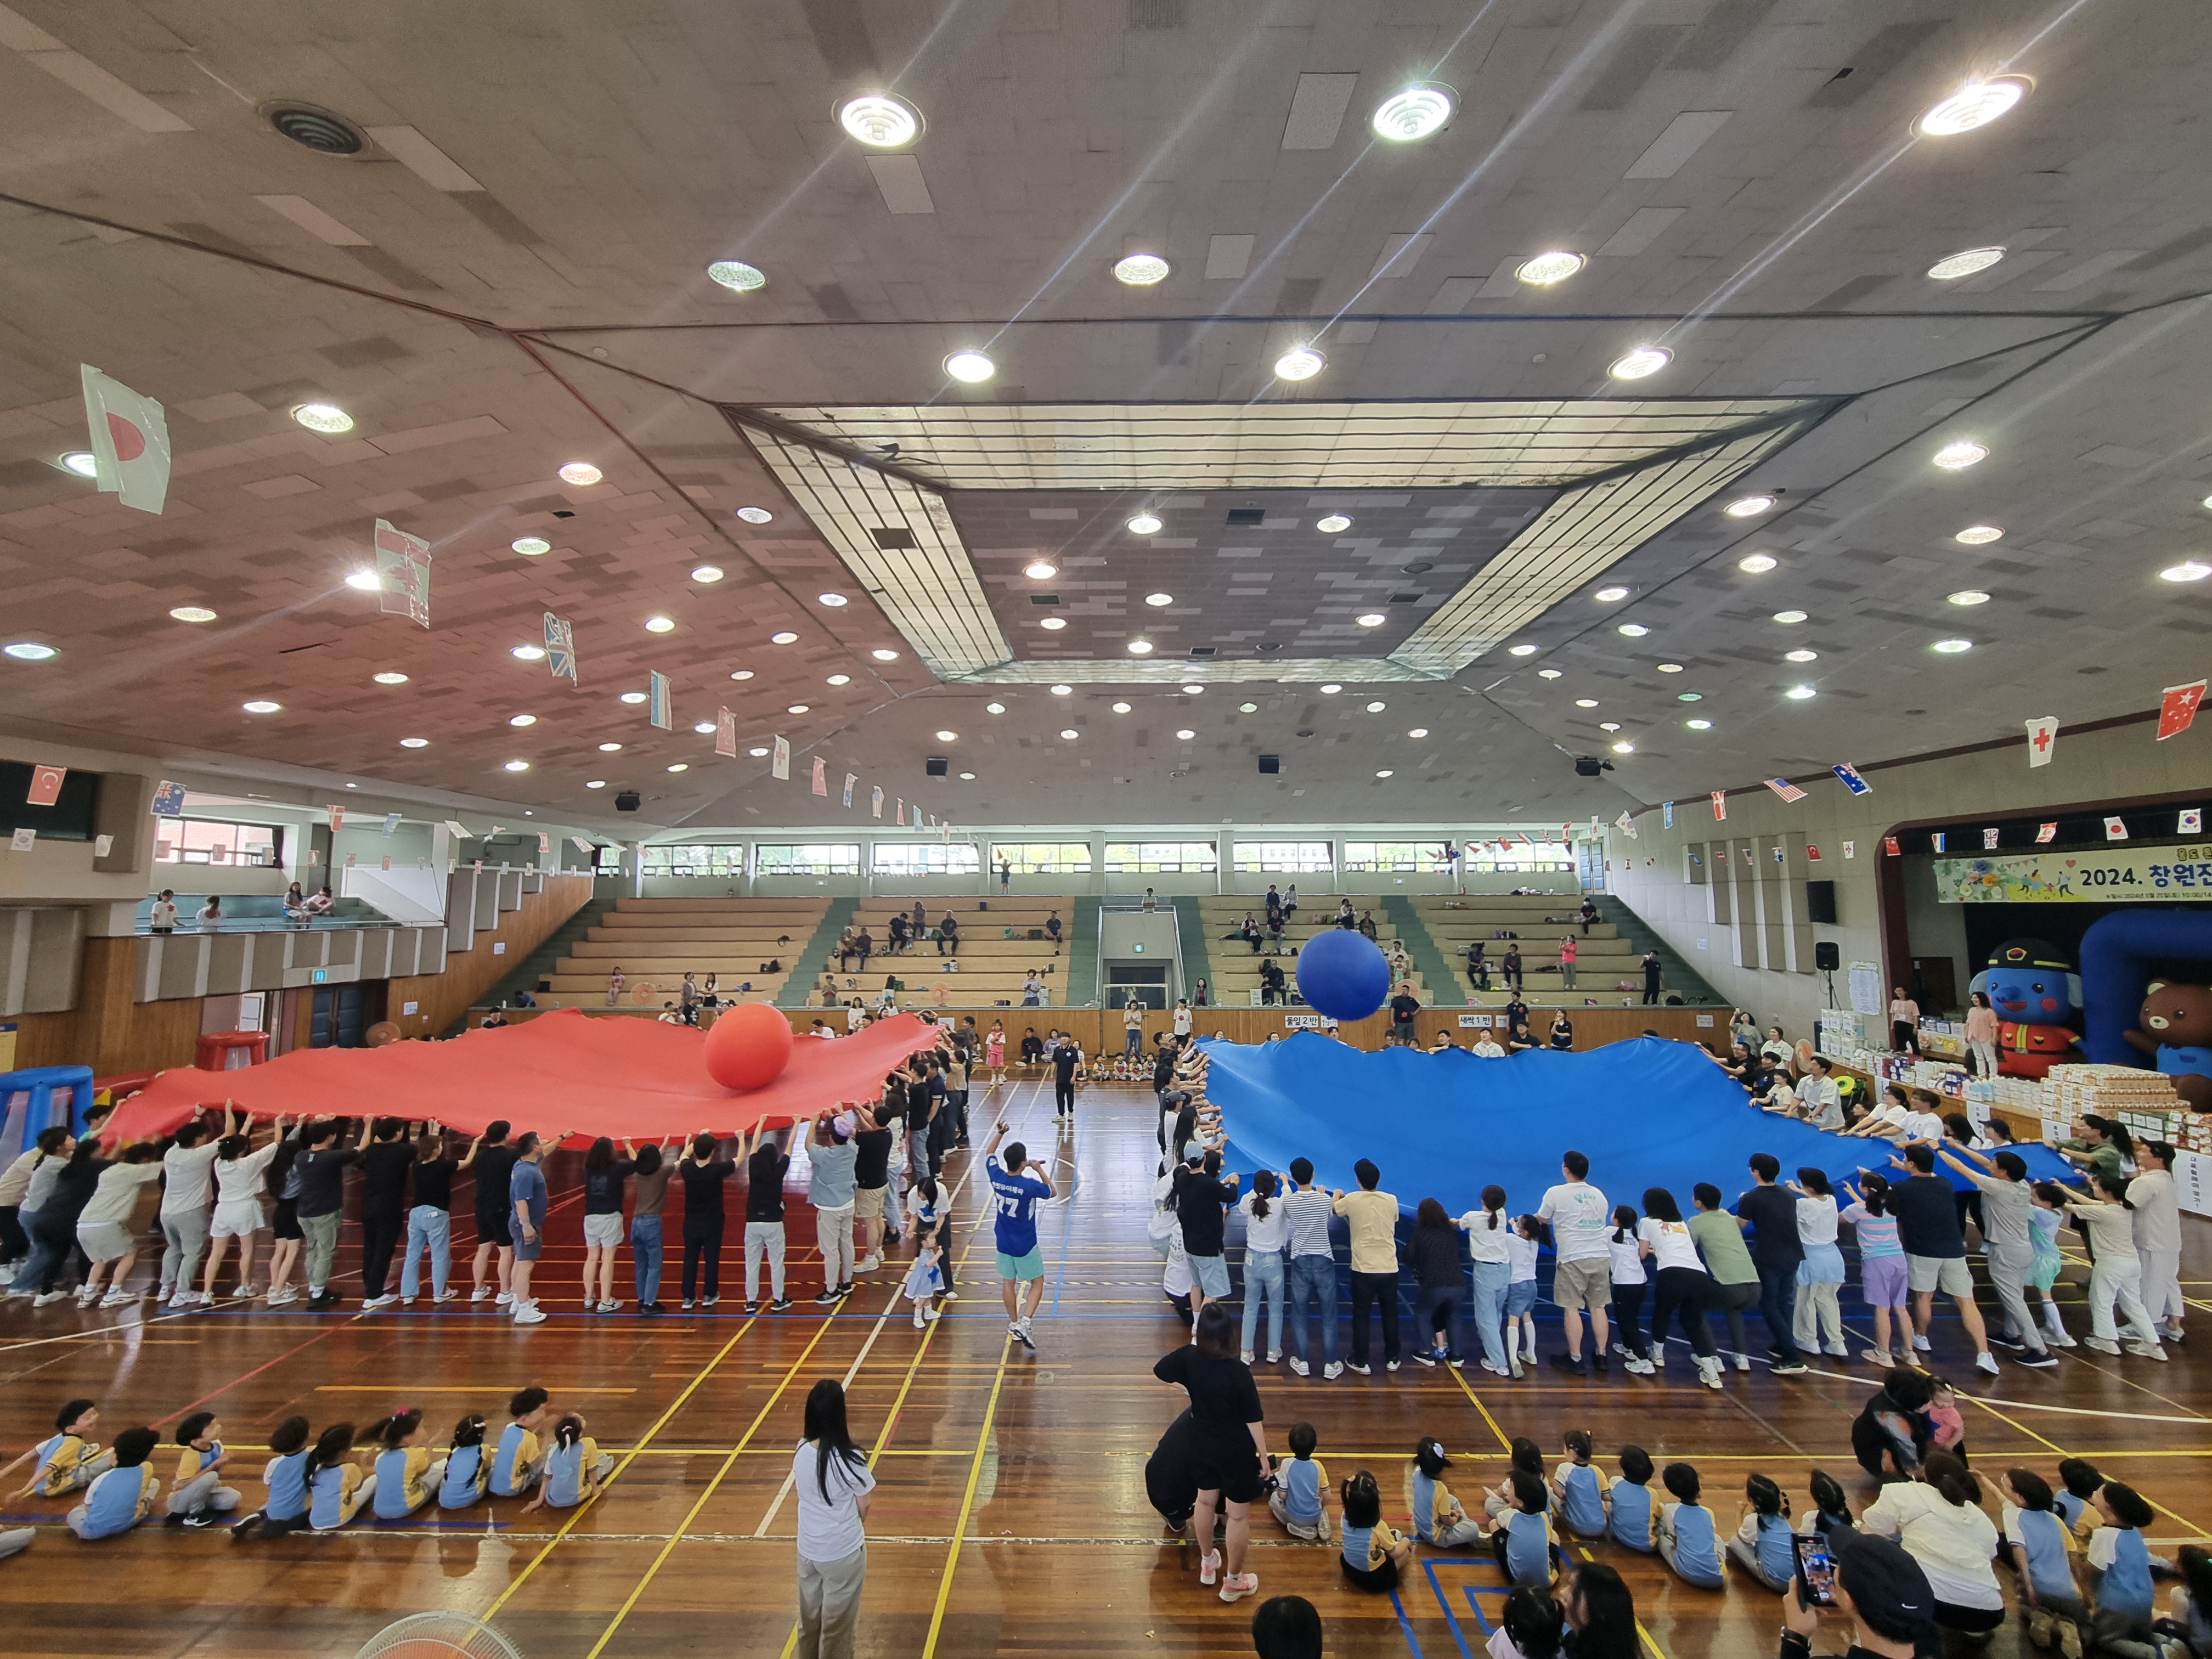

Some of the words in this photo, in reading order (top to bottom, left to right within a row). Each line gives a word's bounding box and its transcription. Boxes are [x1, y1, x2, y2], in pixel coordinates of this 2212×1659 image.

[2080, 867, 2143, 886] 2024.
[1286, 1017, 1301, 1026] 풀잎
[995, 1191, 1019, 1218] 77
